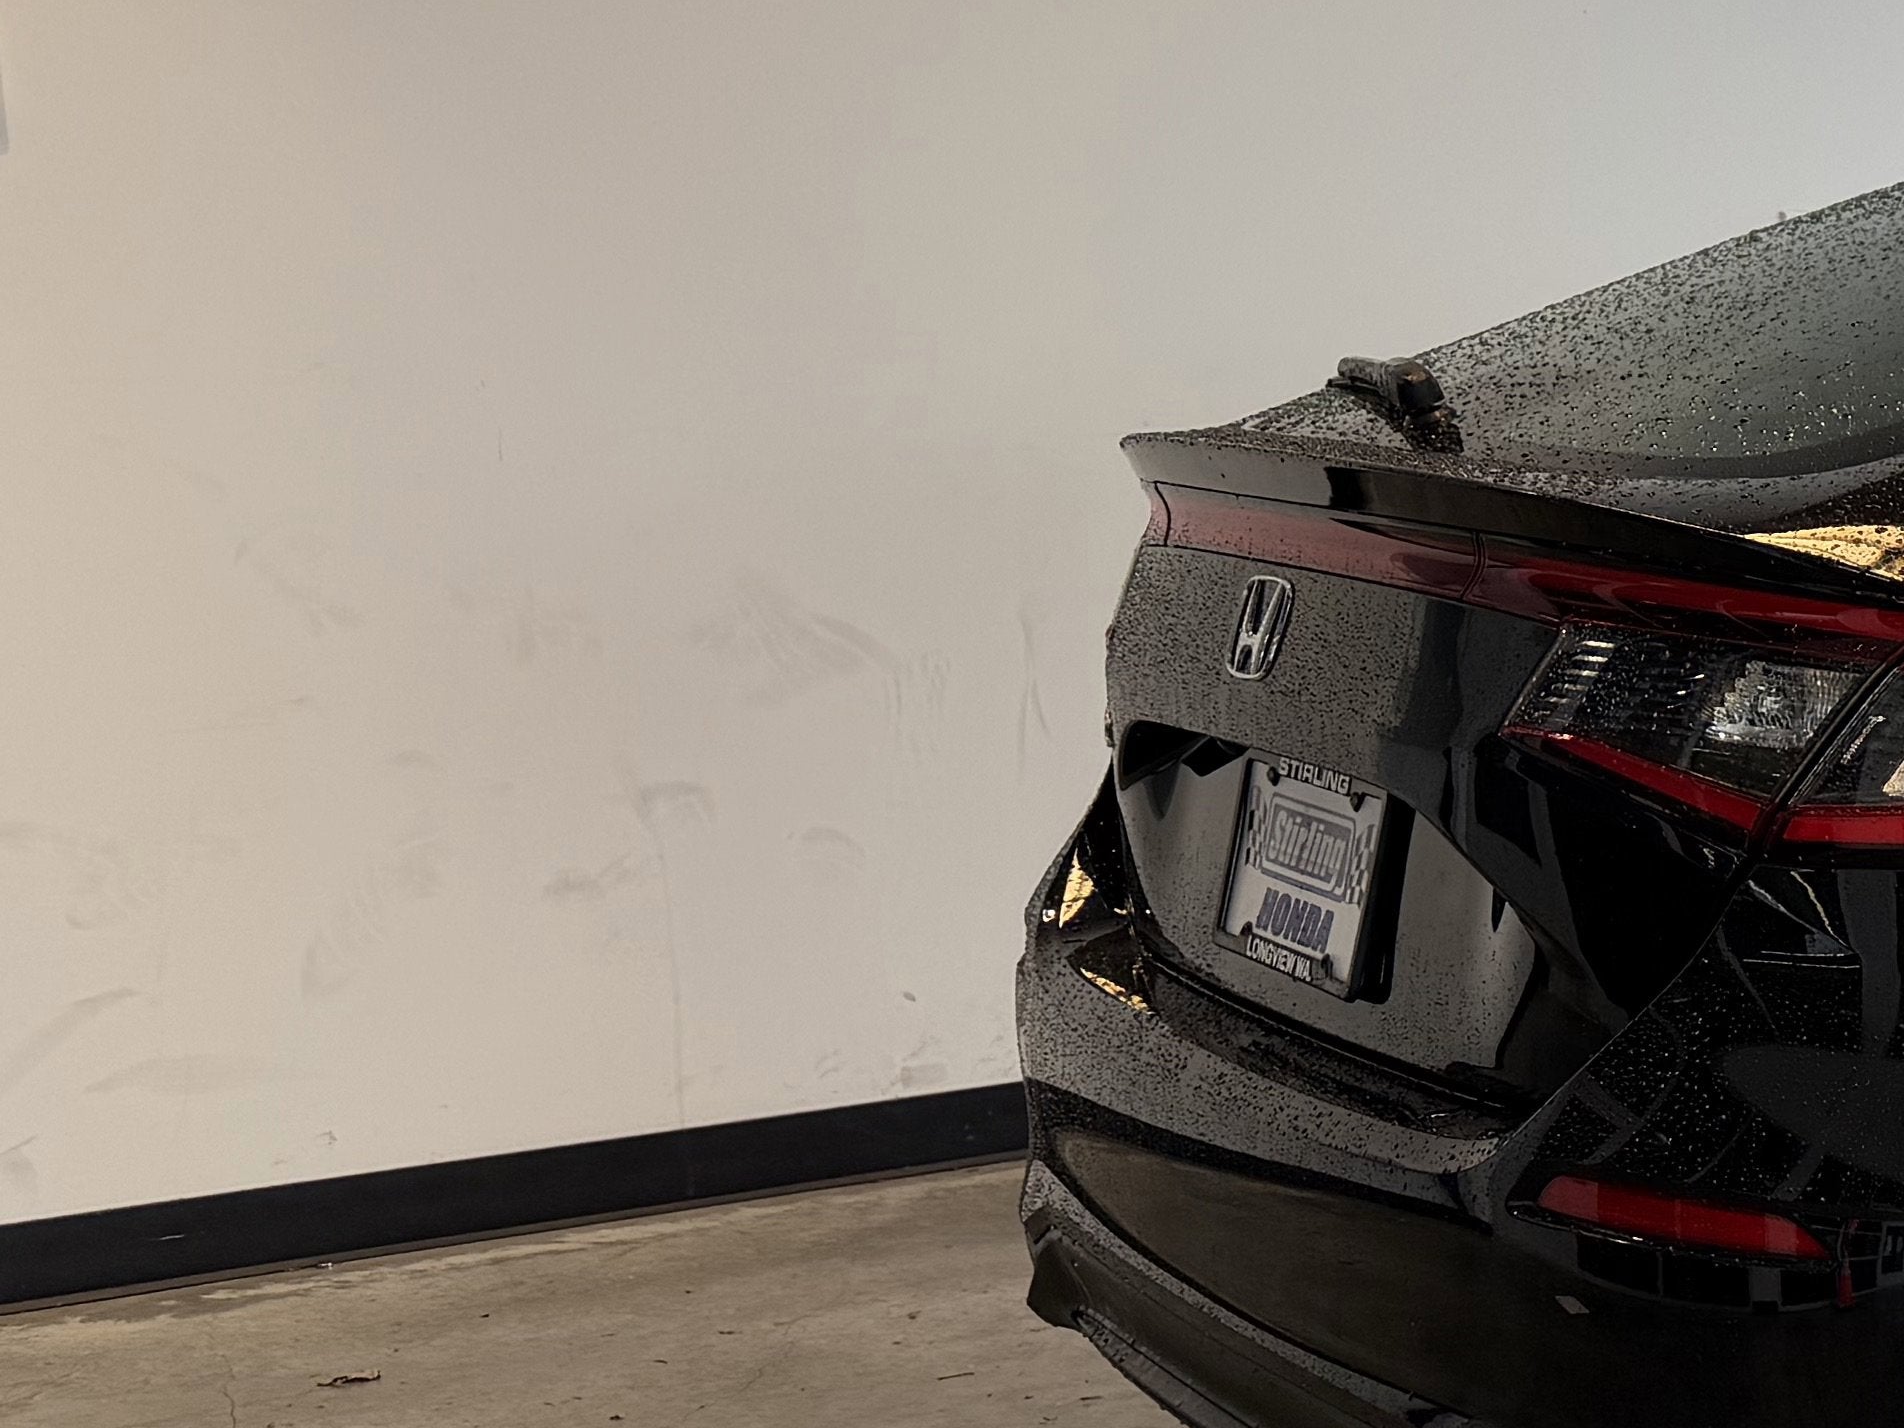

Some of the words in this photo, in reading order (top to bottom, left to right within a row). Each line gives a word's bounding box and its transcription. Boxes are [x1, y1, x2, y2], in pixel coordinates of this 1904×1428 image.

[1279, 756, 1352, 795] STIRLING
[1268, 809, 1347, 896] Stirling
[1255, 887, 1335, 954] HONDA
